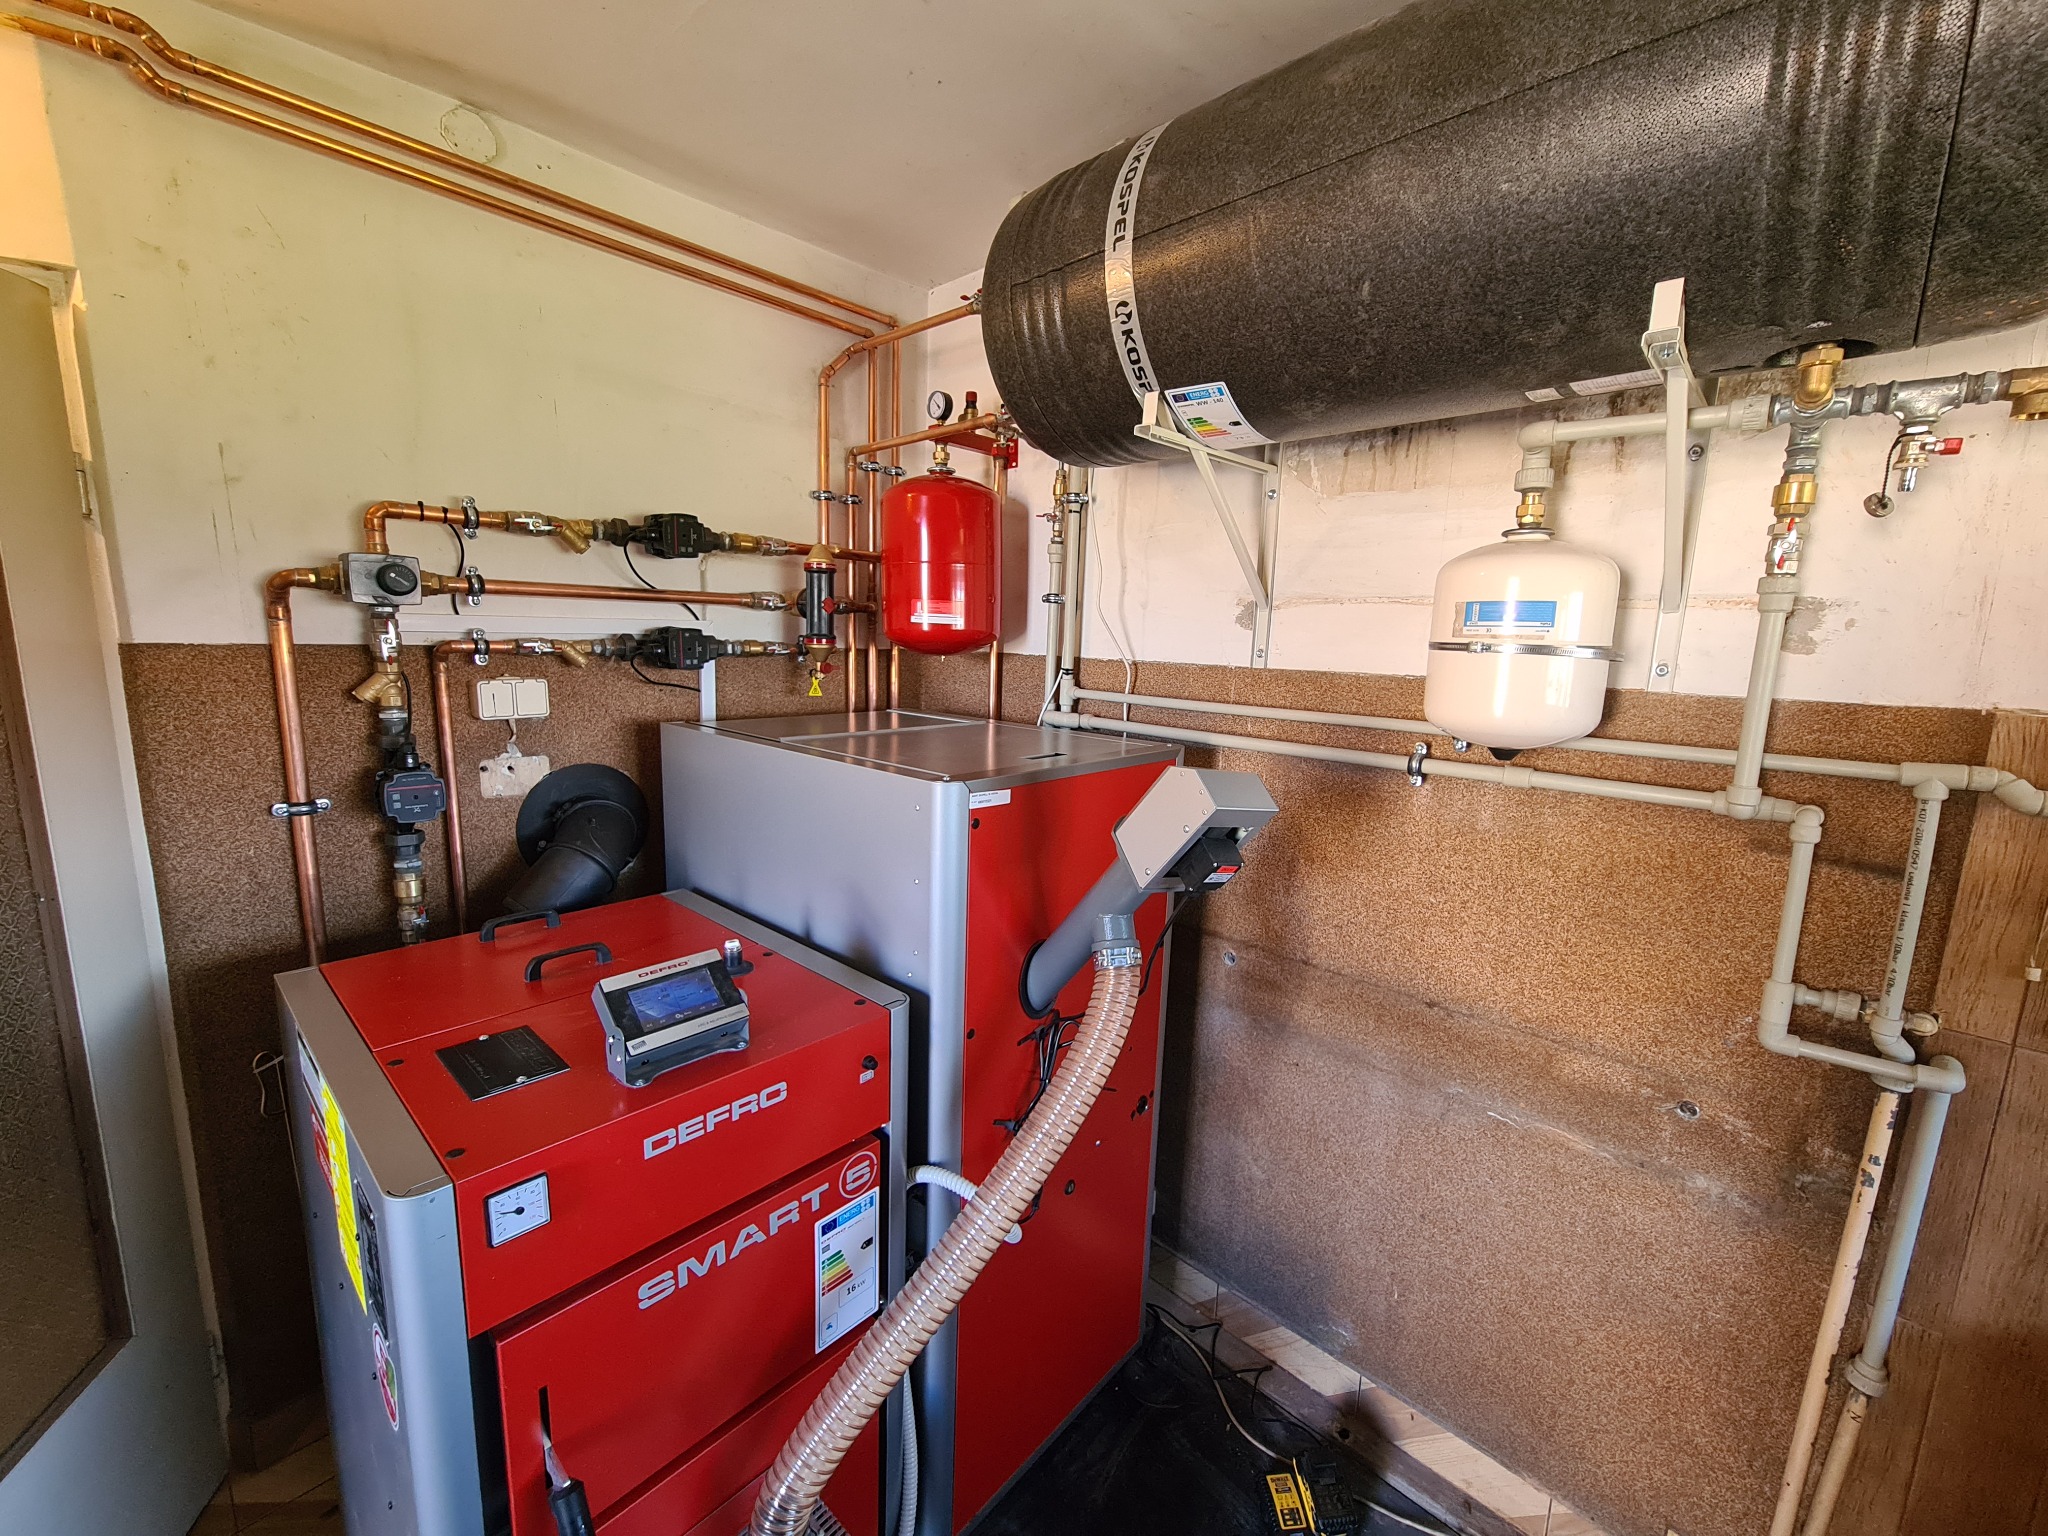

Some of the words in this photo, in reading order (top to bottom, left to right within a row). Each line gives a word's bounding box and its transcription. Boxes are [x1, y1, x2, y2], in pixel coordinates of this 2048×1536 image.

[1113, 151, 1146, 253] KOSPEL
[638, 961, 688, 979] DEFRO
[643, 1081, 788, 1161] DEFRO
[638, 1182, 830, 1310] SMART
[845, 1160, 871, 1191] 5
[846, 1283, 857, 1296] 16
